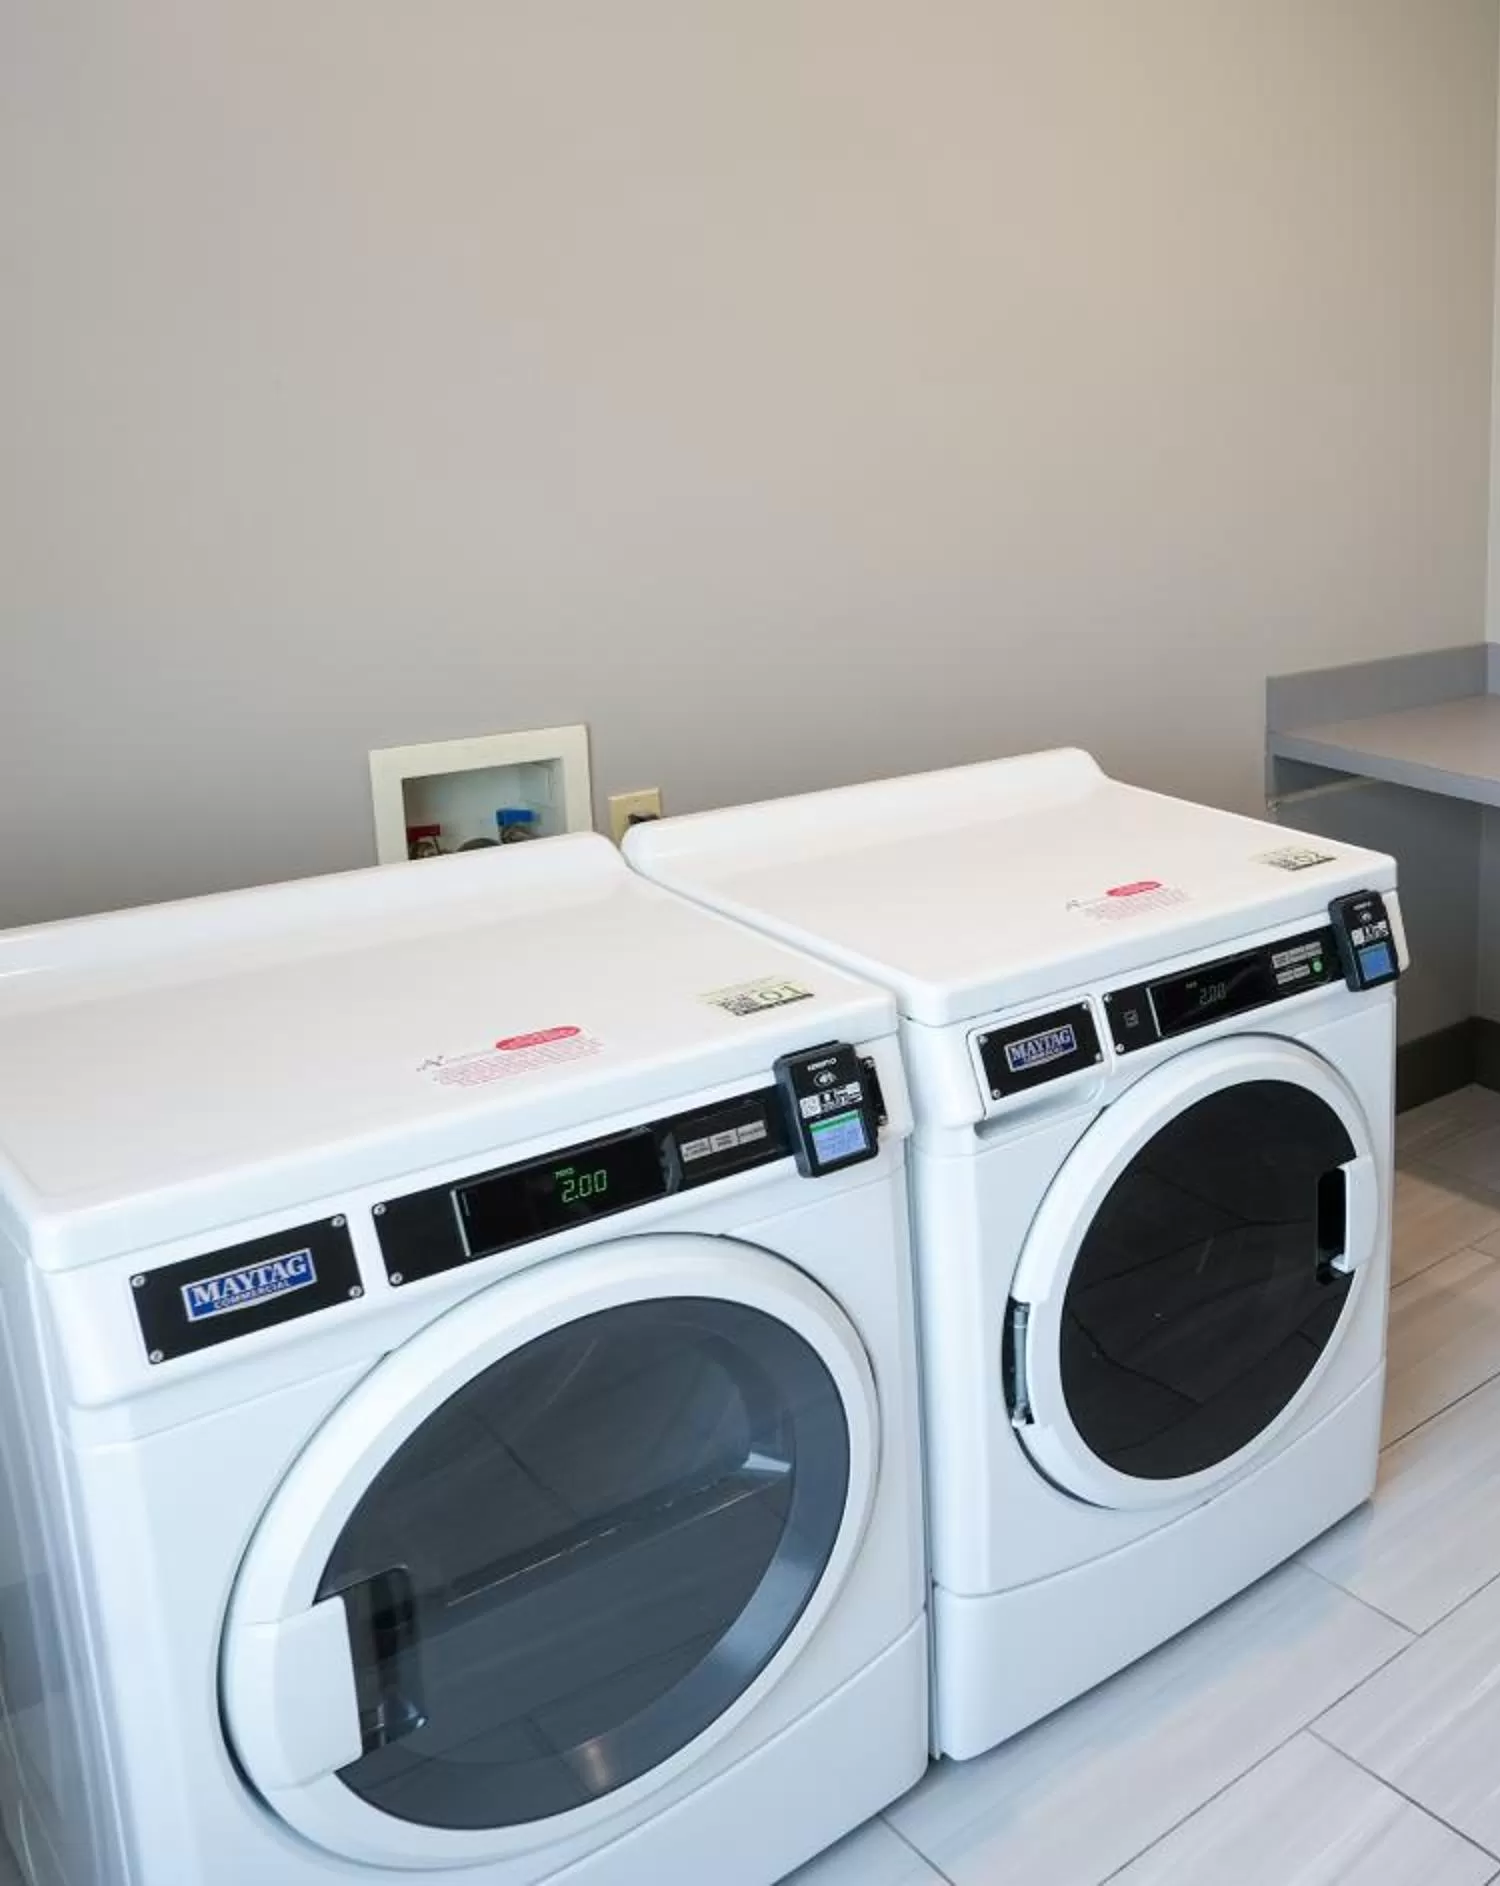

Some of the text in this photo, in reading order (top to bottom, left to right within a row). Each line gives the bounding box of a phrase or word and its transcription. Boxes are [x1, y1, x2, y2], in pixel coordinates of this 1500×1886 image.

[1009, 1029, 1072, 1062] MAYTAG
[562, 1169, 607, 1203] 2.00
[191, 1254, 308, 1308] MAYTAG
[214, 1280, 290, 1310] COMMERCIAL
